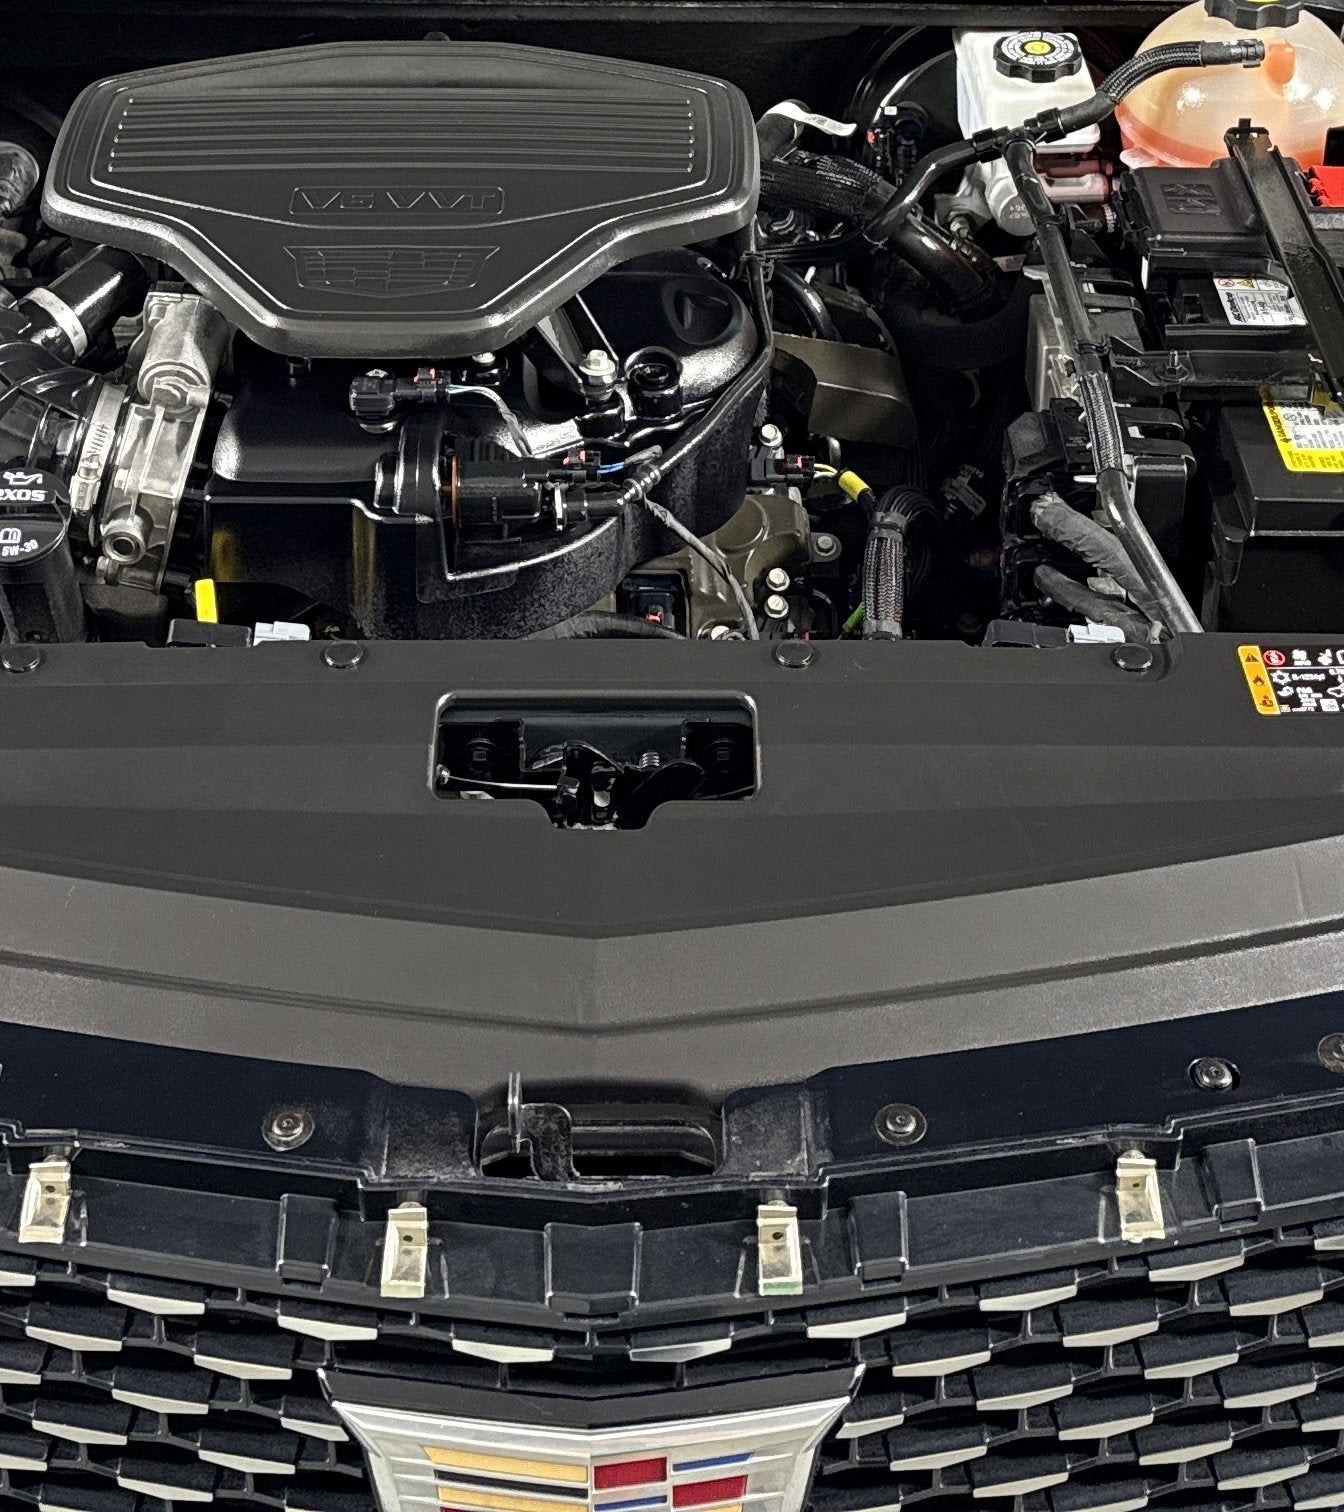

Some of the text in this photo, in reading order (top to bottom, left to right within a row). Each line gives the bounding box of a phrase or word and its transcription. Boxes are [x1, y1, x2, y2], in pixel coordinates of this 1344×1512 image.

[301, 191, 496, 209] V6 VVT
[1, 539, 39, 557] 5W-30
